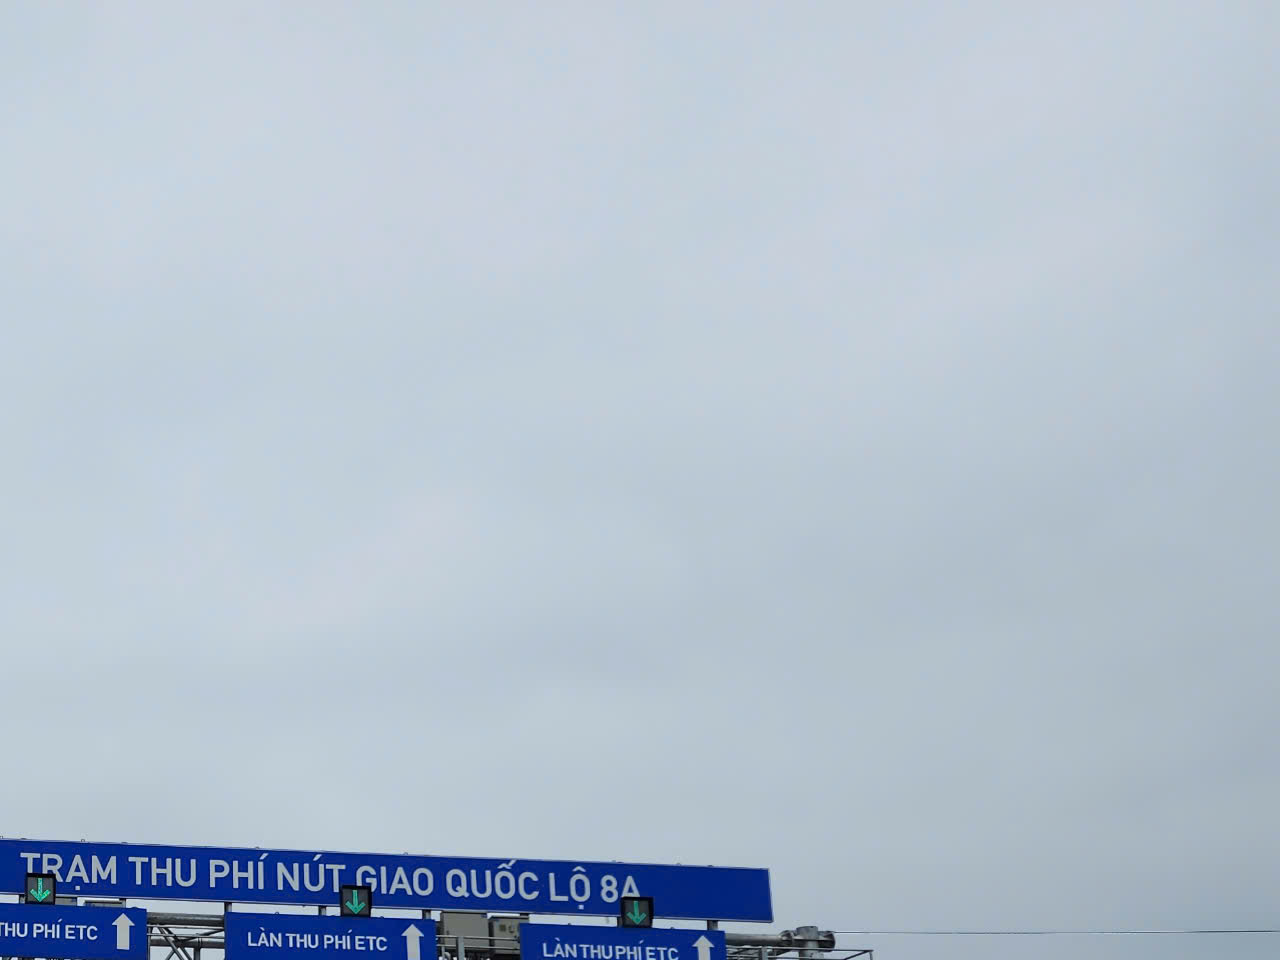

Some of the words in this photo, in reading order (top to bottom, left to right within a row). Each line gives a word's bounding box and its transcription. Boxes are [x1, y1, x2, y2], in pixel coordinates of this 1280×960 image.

[20, 852, 117, 891] TRẠM
[128, 856, 197, 887] THU
[209, 853, 269, 890] PHÍ
[276, 854, 346, 893] NÚT
[356, 865, 434, 896] GIAO
[445, 859, 539, 900] QUỐC
[548, 866, 591, 909] LỘ
[600, 874, 640, 903] 8A
[32, 918, 63, 939] PHÍ
[65, 924, 98, 940] ETC
[247, 926, 282, 947] LÀN
[285, 932, 319, 949] THU
[323, 929, 353, 950] PHÍ
[355, 935, 388, 951] ETC
[543, 937, 577, 958] LÀN
[578, 943, 613, 960] THU
[615, 940, 644, 960] PHÍ
